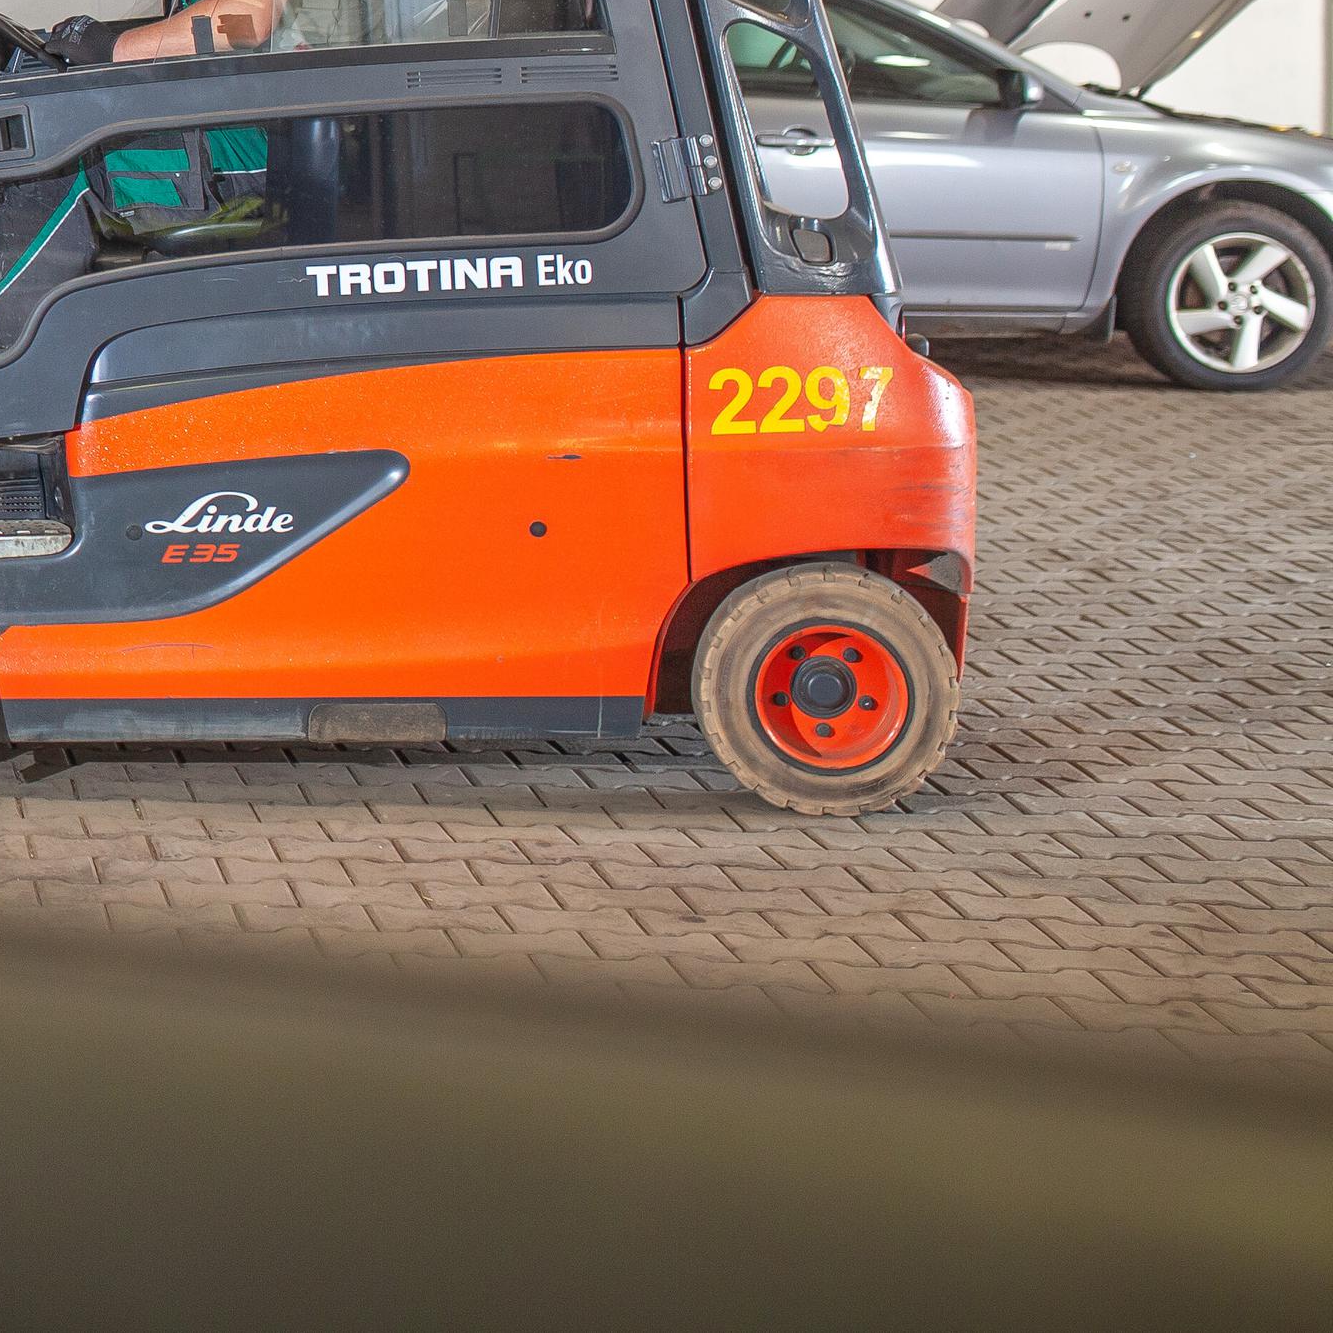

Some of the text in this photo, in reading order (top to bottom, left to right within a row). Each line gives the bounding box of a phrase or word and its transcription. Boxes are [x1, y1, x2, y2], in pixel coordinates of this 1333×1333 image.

[306, 254, 593, 297] TROTINA Eko
[708, 365, 894, 436] 2297
[144, 491, 294, 534] Linde
